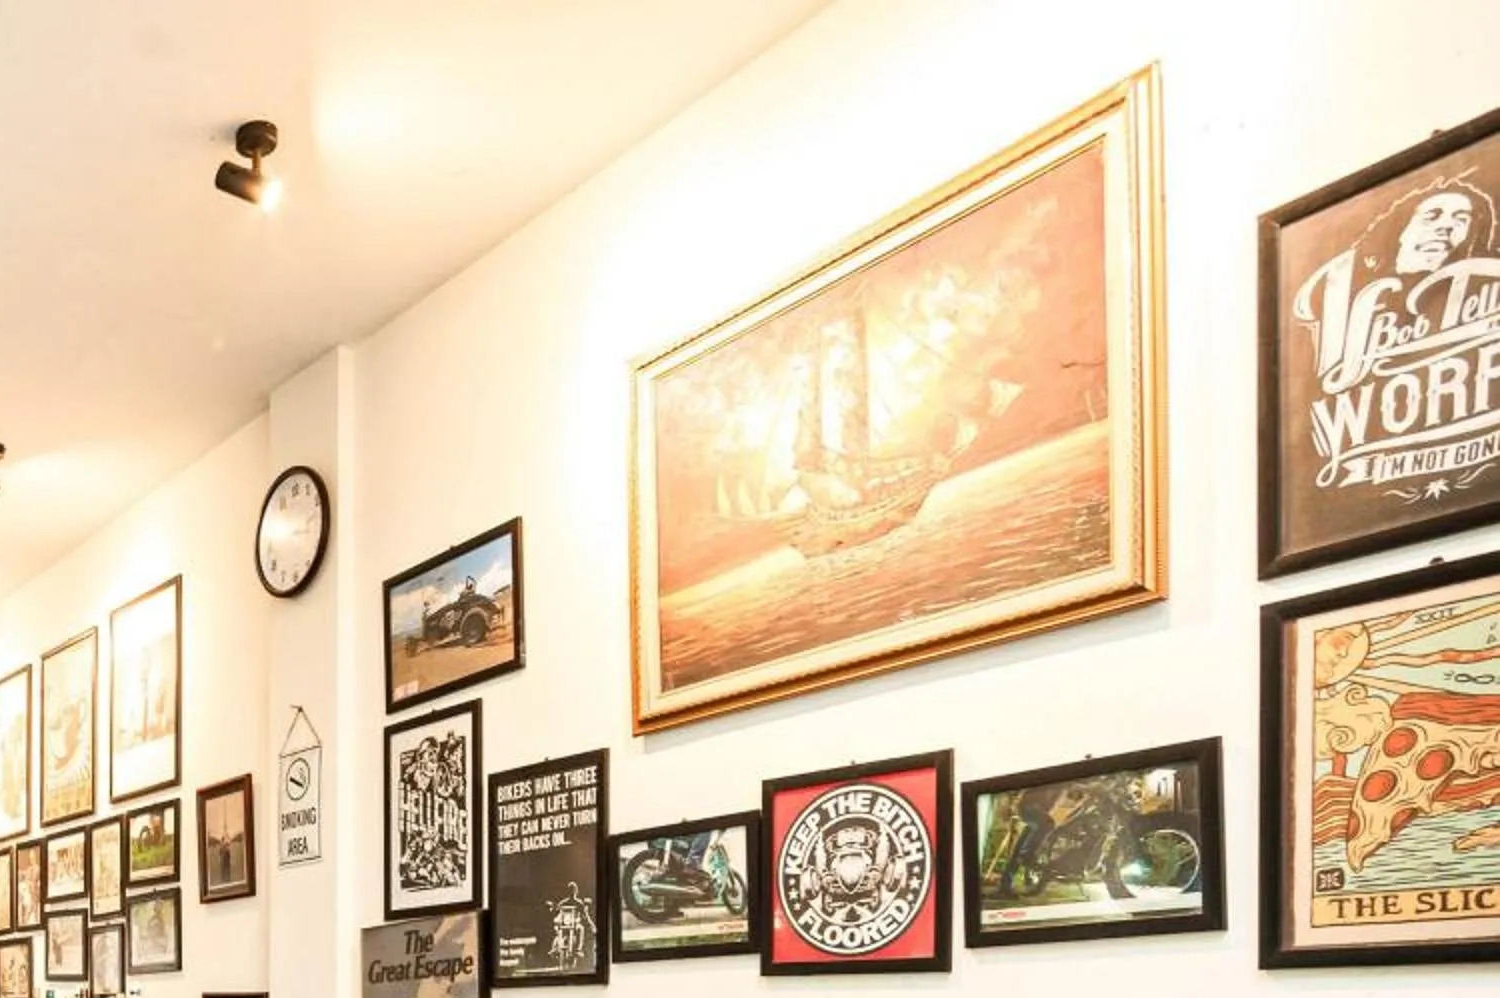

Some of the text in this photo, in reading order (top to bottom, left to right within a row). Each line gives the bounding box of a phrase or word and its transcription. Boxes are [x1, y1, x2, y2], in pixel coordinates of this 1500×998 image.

[1372, 312, 1430, 349] Bob
[1411, 447, 1449, 473] NOT
[1453, 434, 1500, 465] GON
[534, 773, 562, 795] HAVE
[564, 765, 597, 789] THREE
[281, 806, 317, 832] SMOKING
[498, 786, 597, 822] THINGS IN LIFE THAT
[521, 818, 539, 836] CAN
[541, 813, 570, 833] NEVER
[572, 808, 597, 827] TURN
[785, 792, 924, 875] KEEP THE BITCH
[287, 835, 309, 857] AREA
[522, 833, 551, 852] BACKS
[1329, 887, 1497, 919] THE SLIC
[798, 899, 911, 947] FLOORED
[404, 930, 434, 955] The
[368, 953, 473, 985] Great Escape
